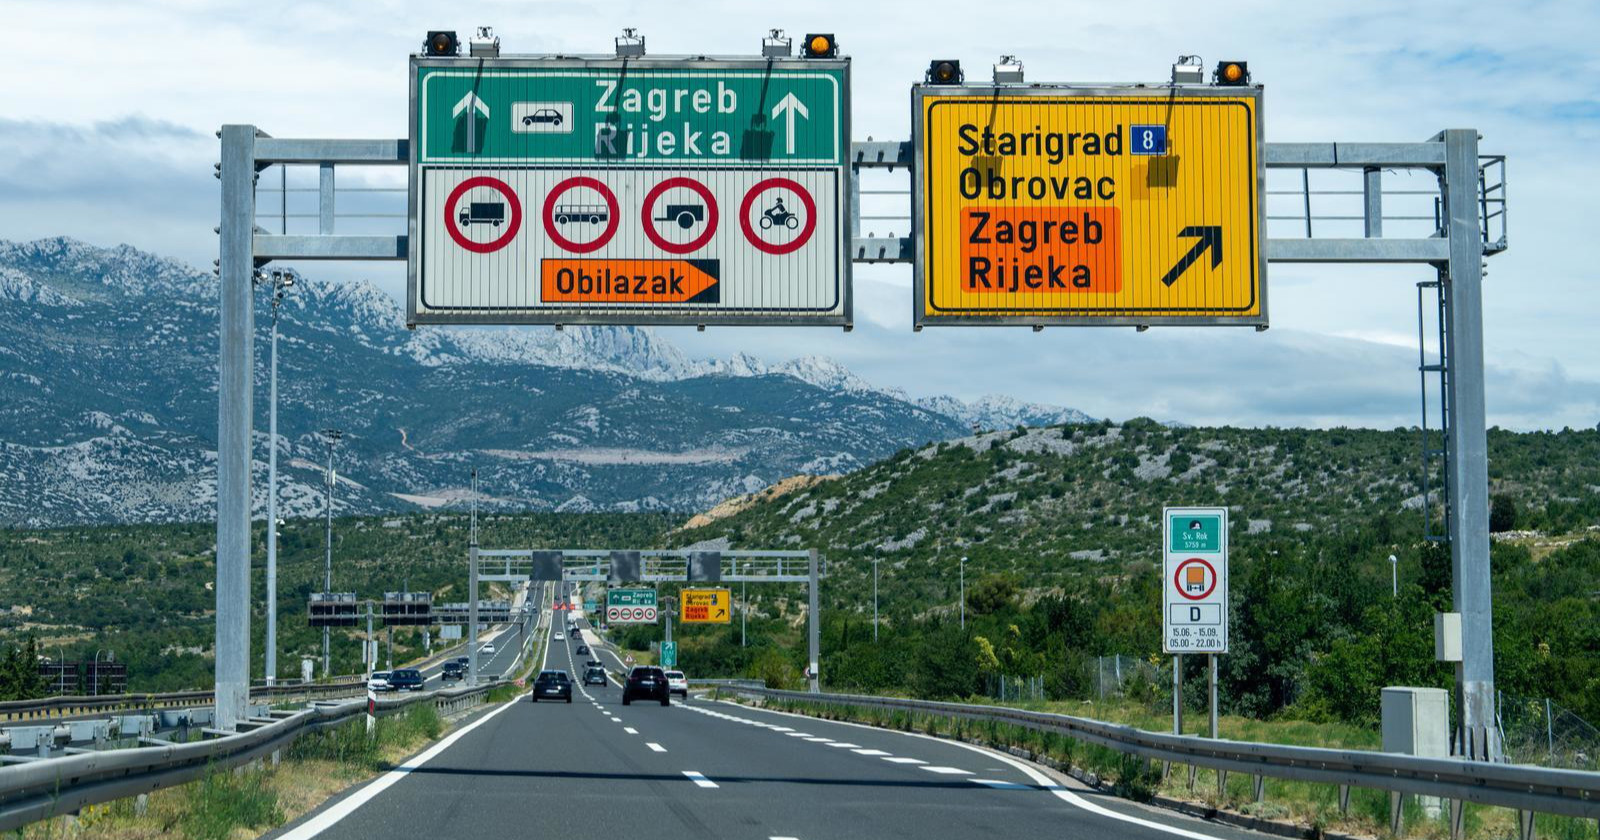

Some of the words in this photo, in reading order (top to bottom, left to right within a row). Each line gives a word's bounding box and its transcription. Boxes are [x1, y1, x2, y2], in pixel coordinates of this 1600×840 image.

[594, 80, 737, 121] Zagreb
[594, 122, 731, 158] Rijeka
[958, 124, 1123, 165] Starigrad
[1142, 130, 1154, 150] 8
[960, 167, 1116, 200] Obrovac
[969, 212, 1103, 254] Zagreb
[557, 268, 685, 295] Obilazak
[969, 256, 1091, 293] Rijeka
[1182, 532, 1193, 540] Sv.
[1196, 532, 1208, 540] Rok
[1190, 606, 1200, 622] D
[1170, 639, 1190, 648] 05.00
[1196, 639, 1216, 648] 22.00
[1216, 639, 1221, 648] h
[1173, 628, 1192, 636] 15.06.
[1199, 628, 1218, 636] 15.09.
